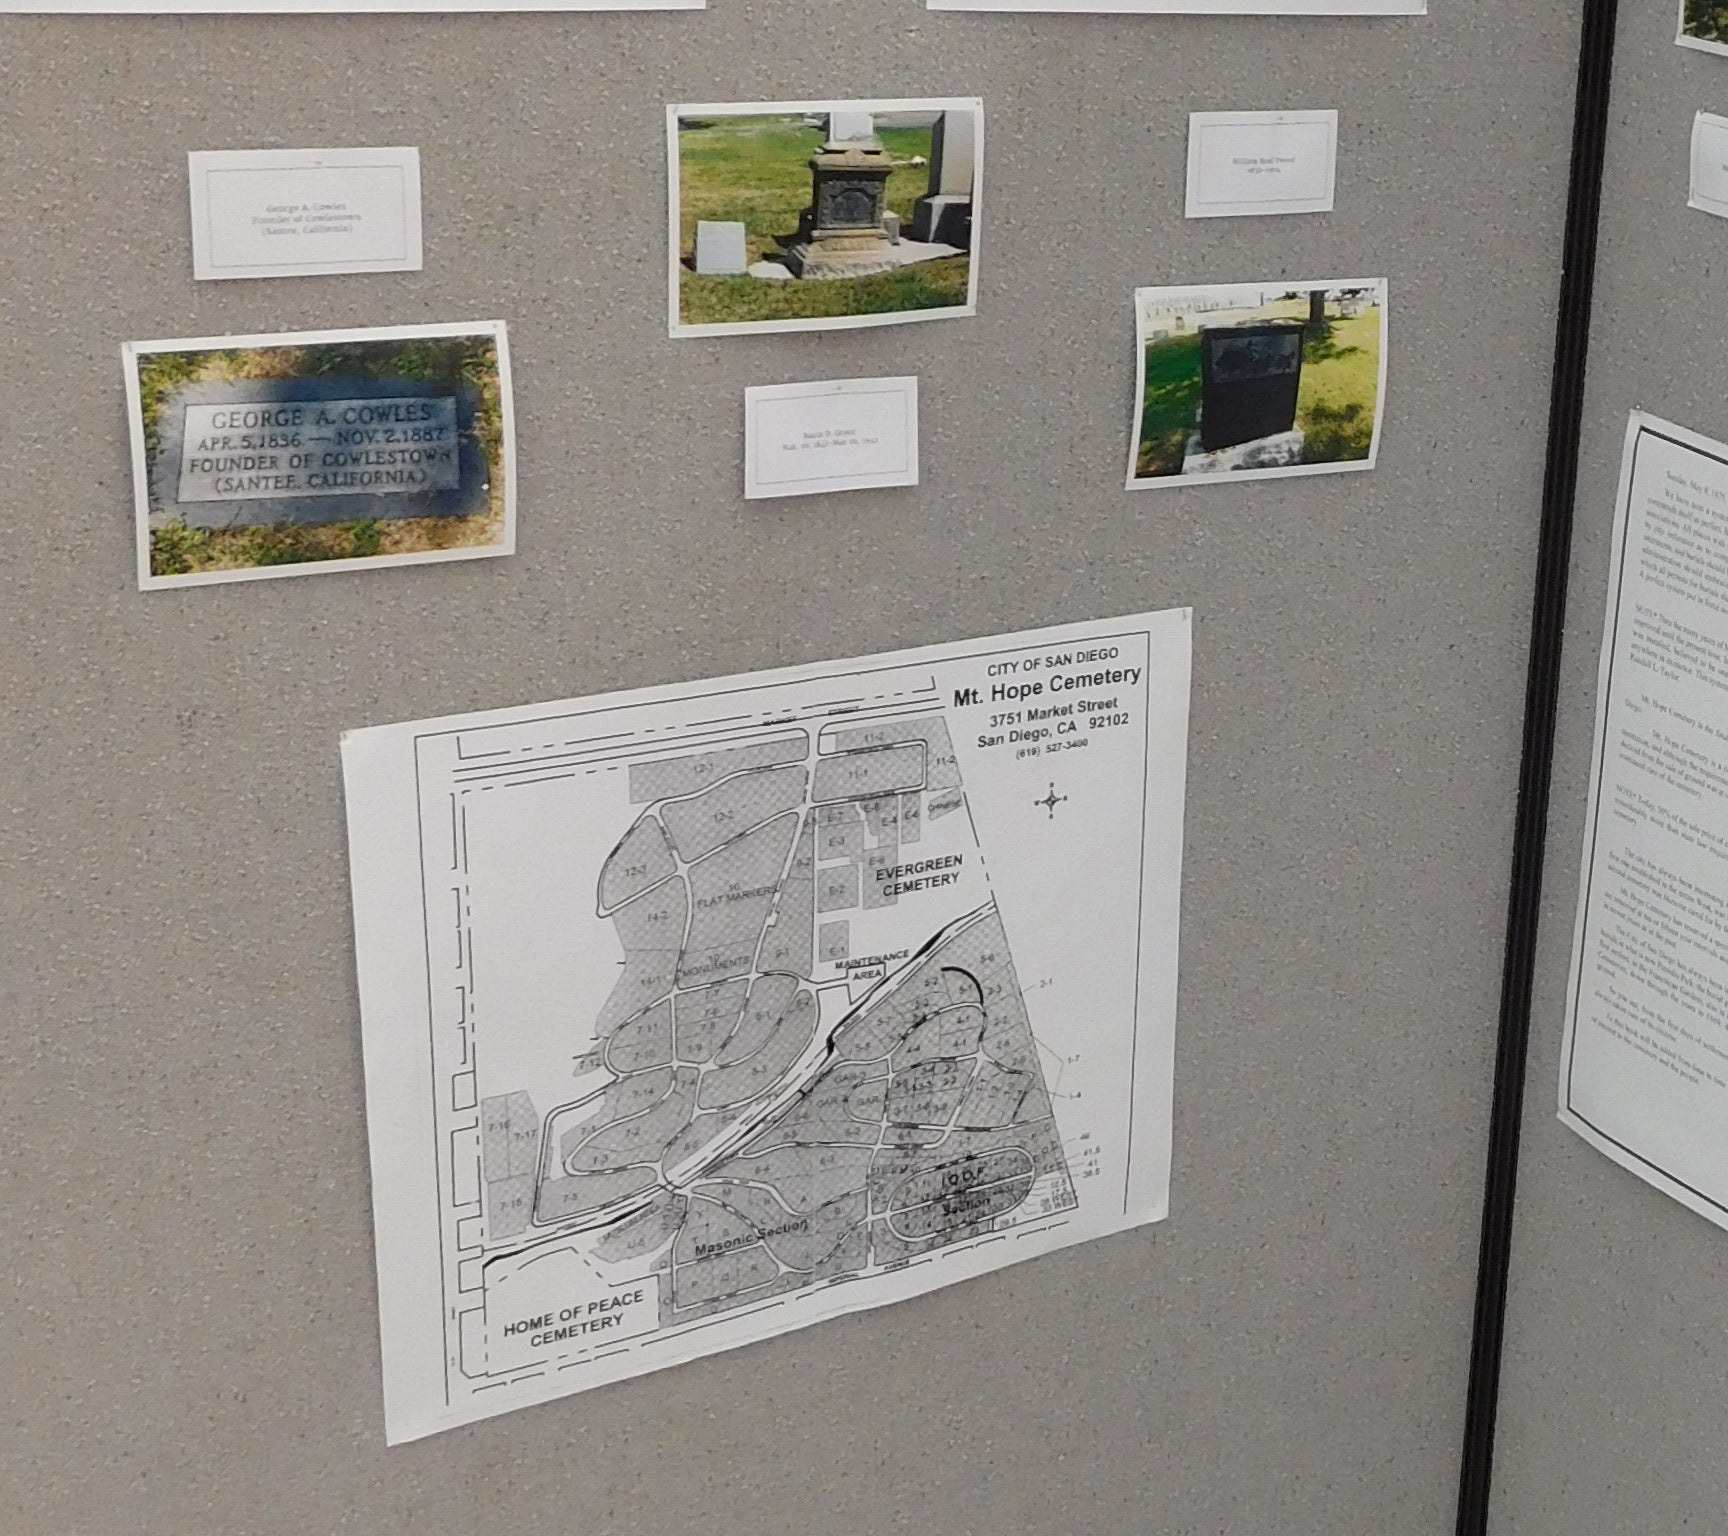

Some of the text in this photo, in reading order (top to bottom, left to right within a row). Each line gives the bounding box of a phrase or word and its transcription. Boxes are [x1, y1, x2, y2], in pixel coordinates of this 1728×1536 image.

[210, 409, 305, 430] GEORGE
[343, 404, 432, 425] COWLES
[188, 447, 452, 474] FOUNDER OF COWLESTOWN
[987, 646, 1119, 677] CITY OF SAN DIEGO
[953, 666, 1142, 707] Mt. Hope Cemetery
[989, 697, 1119, 728] 3751 Market Street
[977, 711, 1129, 748] San Diego, CA 92102
[876, 852, 963, 881] EVERGREEN
[882, 870, 960, 897] CEMETERY
[834, 947, 909, 973] MAINTENANCE
[852, 967, 882, 982] AREA
[694, 1216, 808, 1257] Masonic Section
[503, 1287, 644, 1338] HOME OF PEACE
[530, 1311, 624, 1350] CEMETERY
